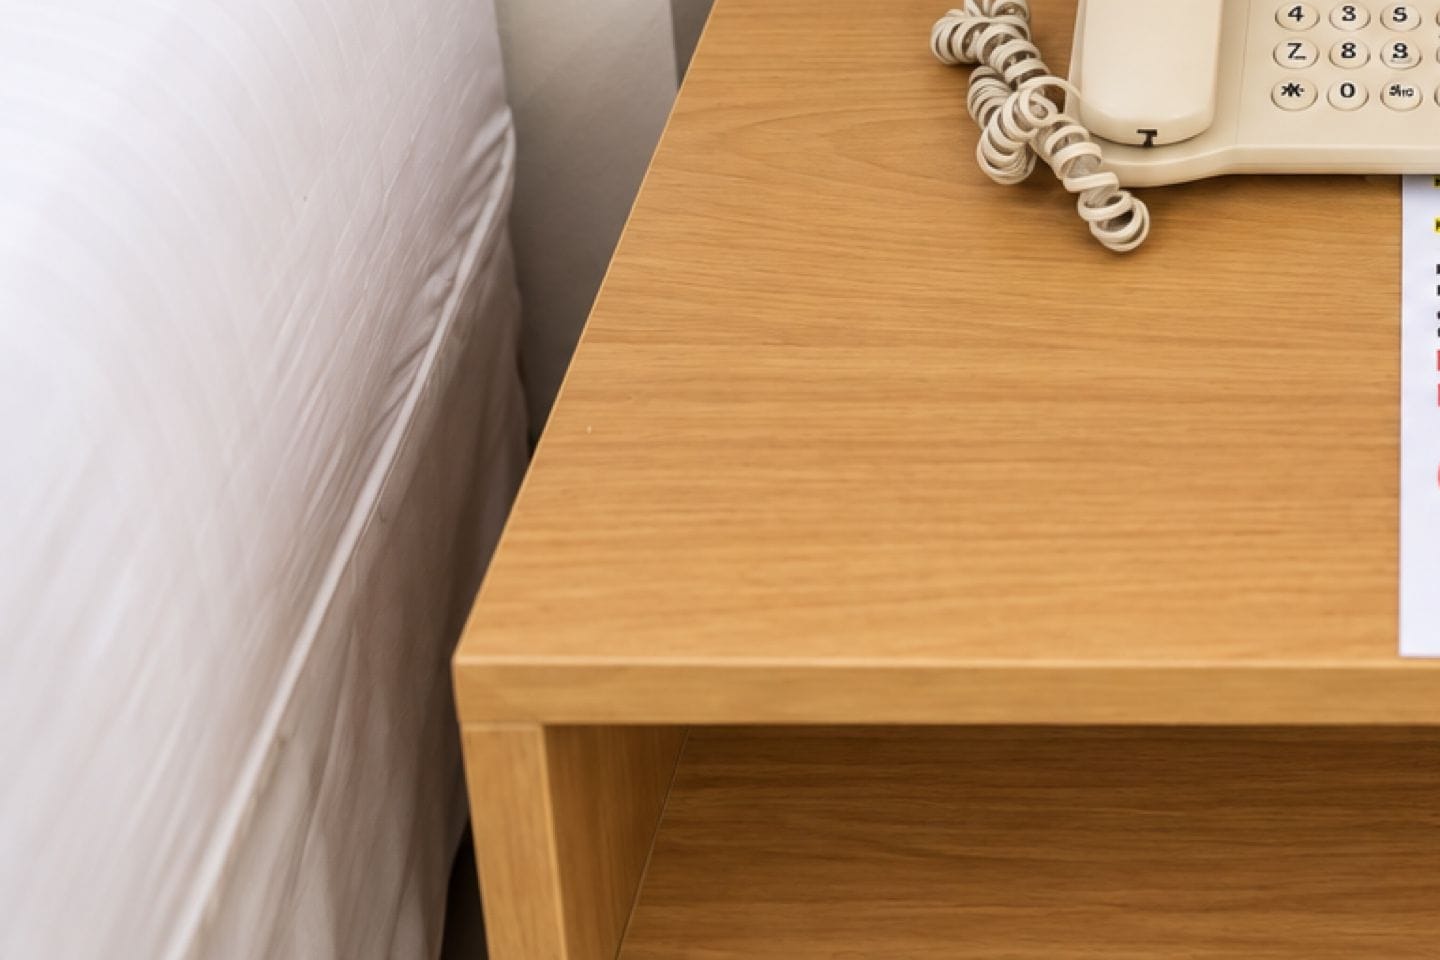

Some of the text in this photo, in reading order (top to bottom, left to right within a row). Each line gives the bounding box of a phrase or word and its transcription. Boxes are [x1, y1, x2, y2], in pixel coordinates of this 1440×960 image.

[1288, 5, 1304, 22] 4
[1342, 43, 1356, 59] 8
[1340, 83, 1355, 98] 0
